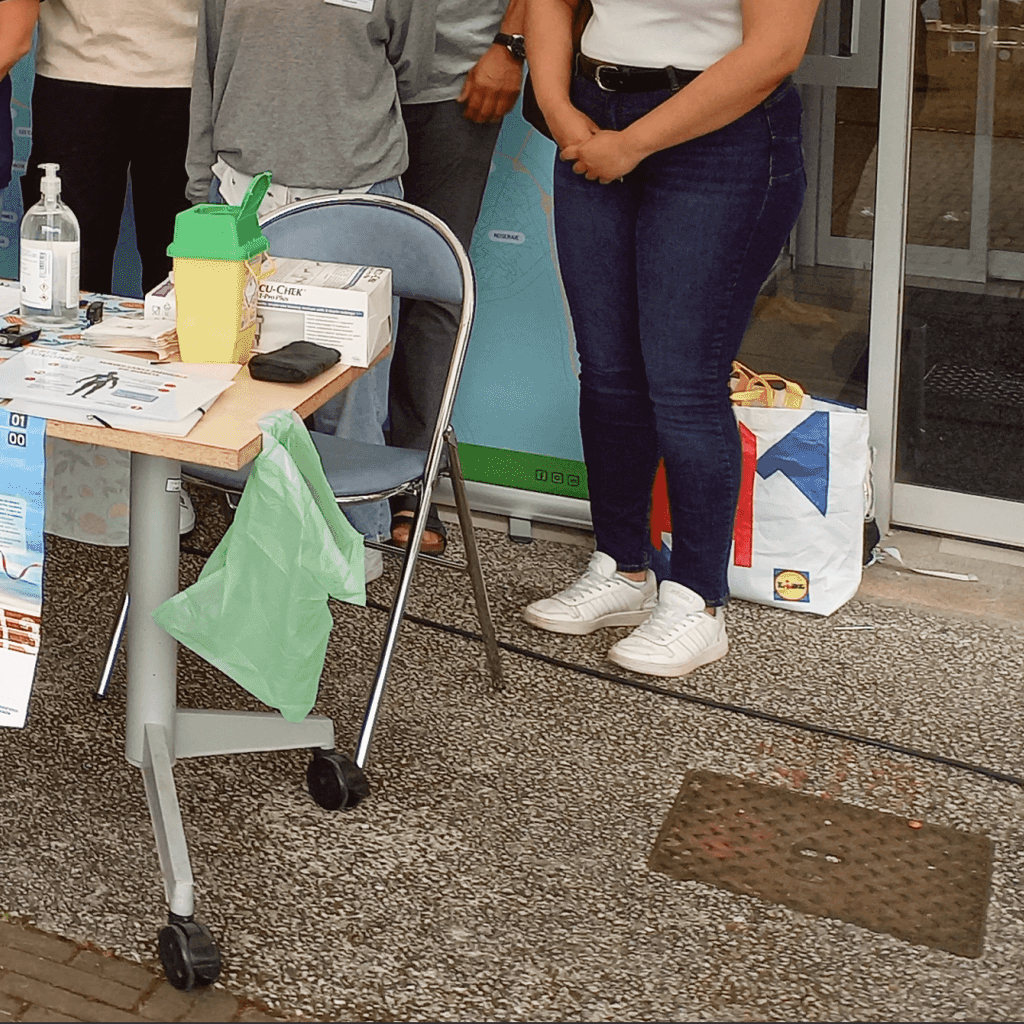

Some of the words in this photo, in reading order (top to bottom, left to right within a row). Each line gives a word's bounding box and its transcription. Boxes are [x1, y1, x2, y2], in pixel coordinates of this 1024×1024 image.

[259, 284, 303, 297] CU-CHEK
[11, 413, 25, 428] 01
[9, 432, 25, 446] 00
